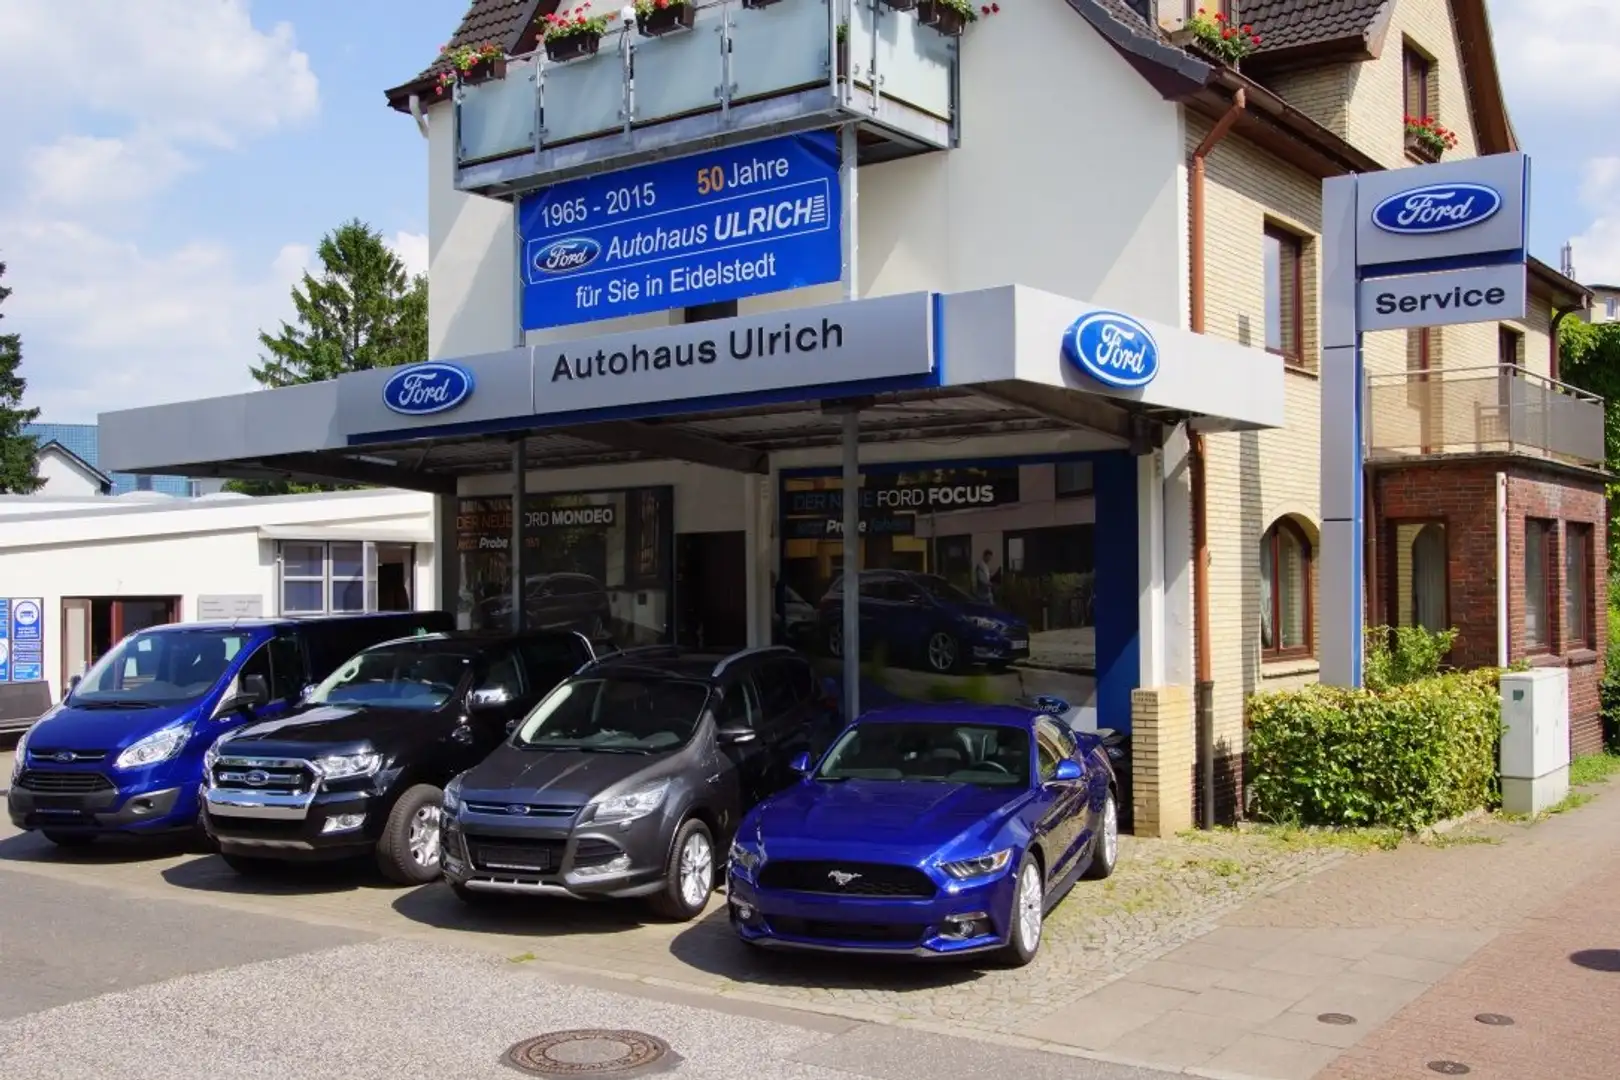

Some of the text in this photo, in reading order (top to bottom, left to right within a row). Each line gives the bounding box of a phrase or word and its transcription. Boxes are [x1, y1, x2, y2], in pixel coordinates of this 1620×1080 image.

[697, 158, 789, 195] 50 Jahre
[541, 197, 587, 228] 1965
[606, 182, 656, 215] 2015
[1397, 191, 1475, 226] Ford
[606, 197, 813, 262] Autohaus ULRICH
[546, 243, 587, 269] Ford
[576, 253, 776, 309] für Sie in Eidelstedt
[1375, 286, 1505, 315] Service
[551, 318, 843, 382] Autohaus Ulrich
[1096, 323, 1146, 375] Ford
[400, 372, 451, 405] Ford
[876, 488, 925, 507] FORD
[928, 485, 995, 505] FOCUS
[552, 509, 613, 525] MONDEO
[479, 537, 508, 549] Probe
